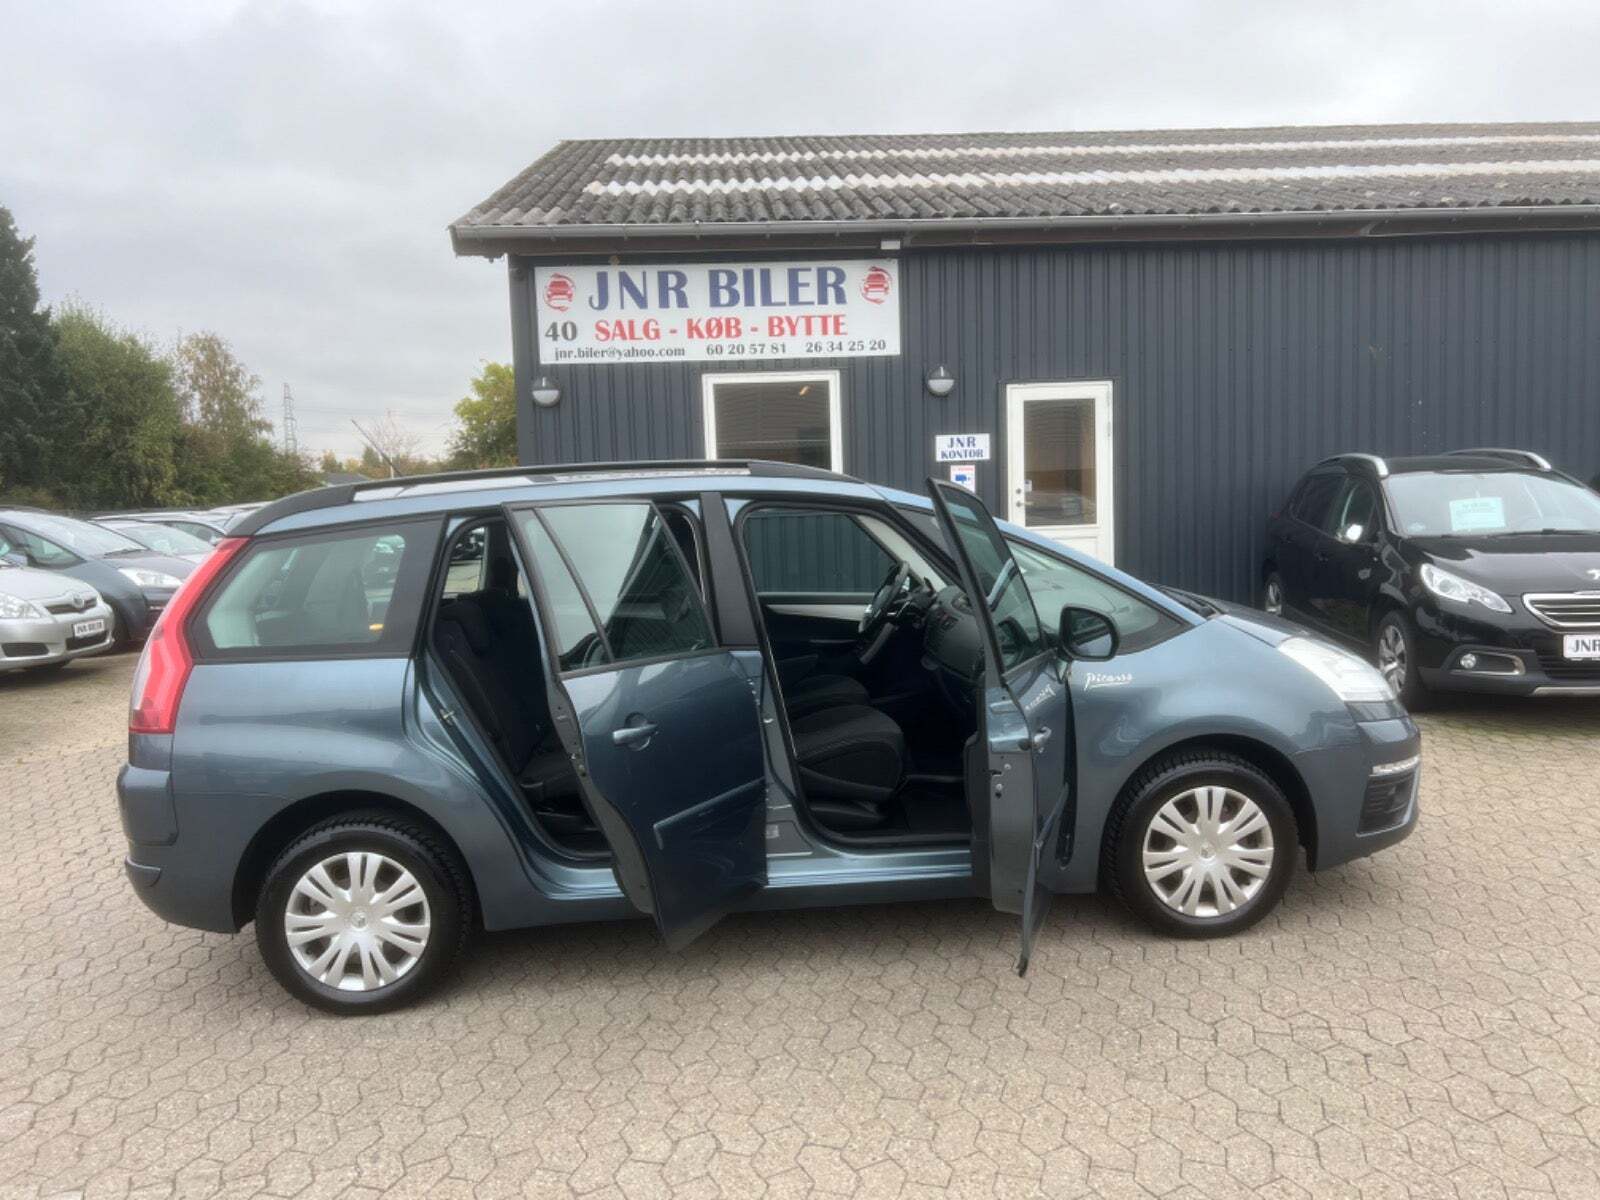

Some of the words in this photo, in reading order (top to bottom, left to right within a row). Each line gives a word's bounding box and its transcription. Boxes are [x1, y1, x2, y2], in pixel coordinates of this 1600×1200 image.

[589, 269, 690, 310] JNR
[708, 266, 848, 308] BILER
[545, 320, 578, 341] 40
[594, 318, 661, 342] SALG
[687, 316, 743, 340] KØB
[768, 314, 848, 337] BYTTE
[555, 346, 685, 361] jnr.biler@yahoo.com
[706, 343, 724, 356] 60
[728, 343, 745, 355] 20
[750, 343, 766, 355] 57
[771, 341, 787, 354] 81
[805, 341, 822, 353] 26
[826, 340, 843, 353] 34
[848, 340, 865, 352] 25
[869, 339, 886, 351] 20
[948, 436, 976, 448] JNR
[941, 448, 984, 459] KONTOR
